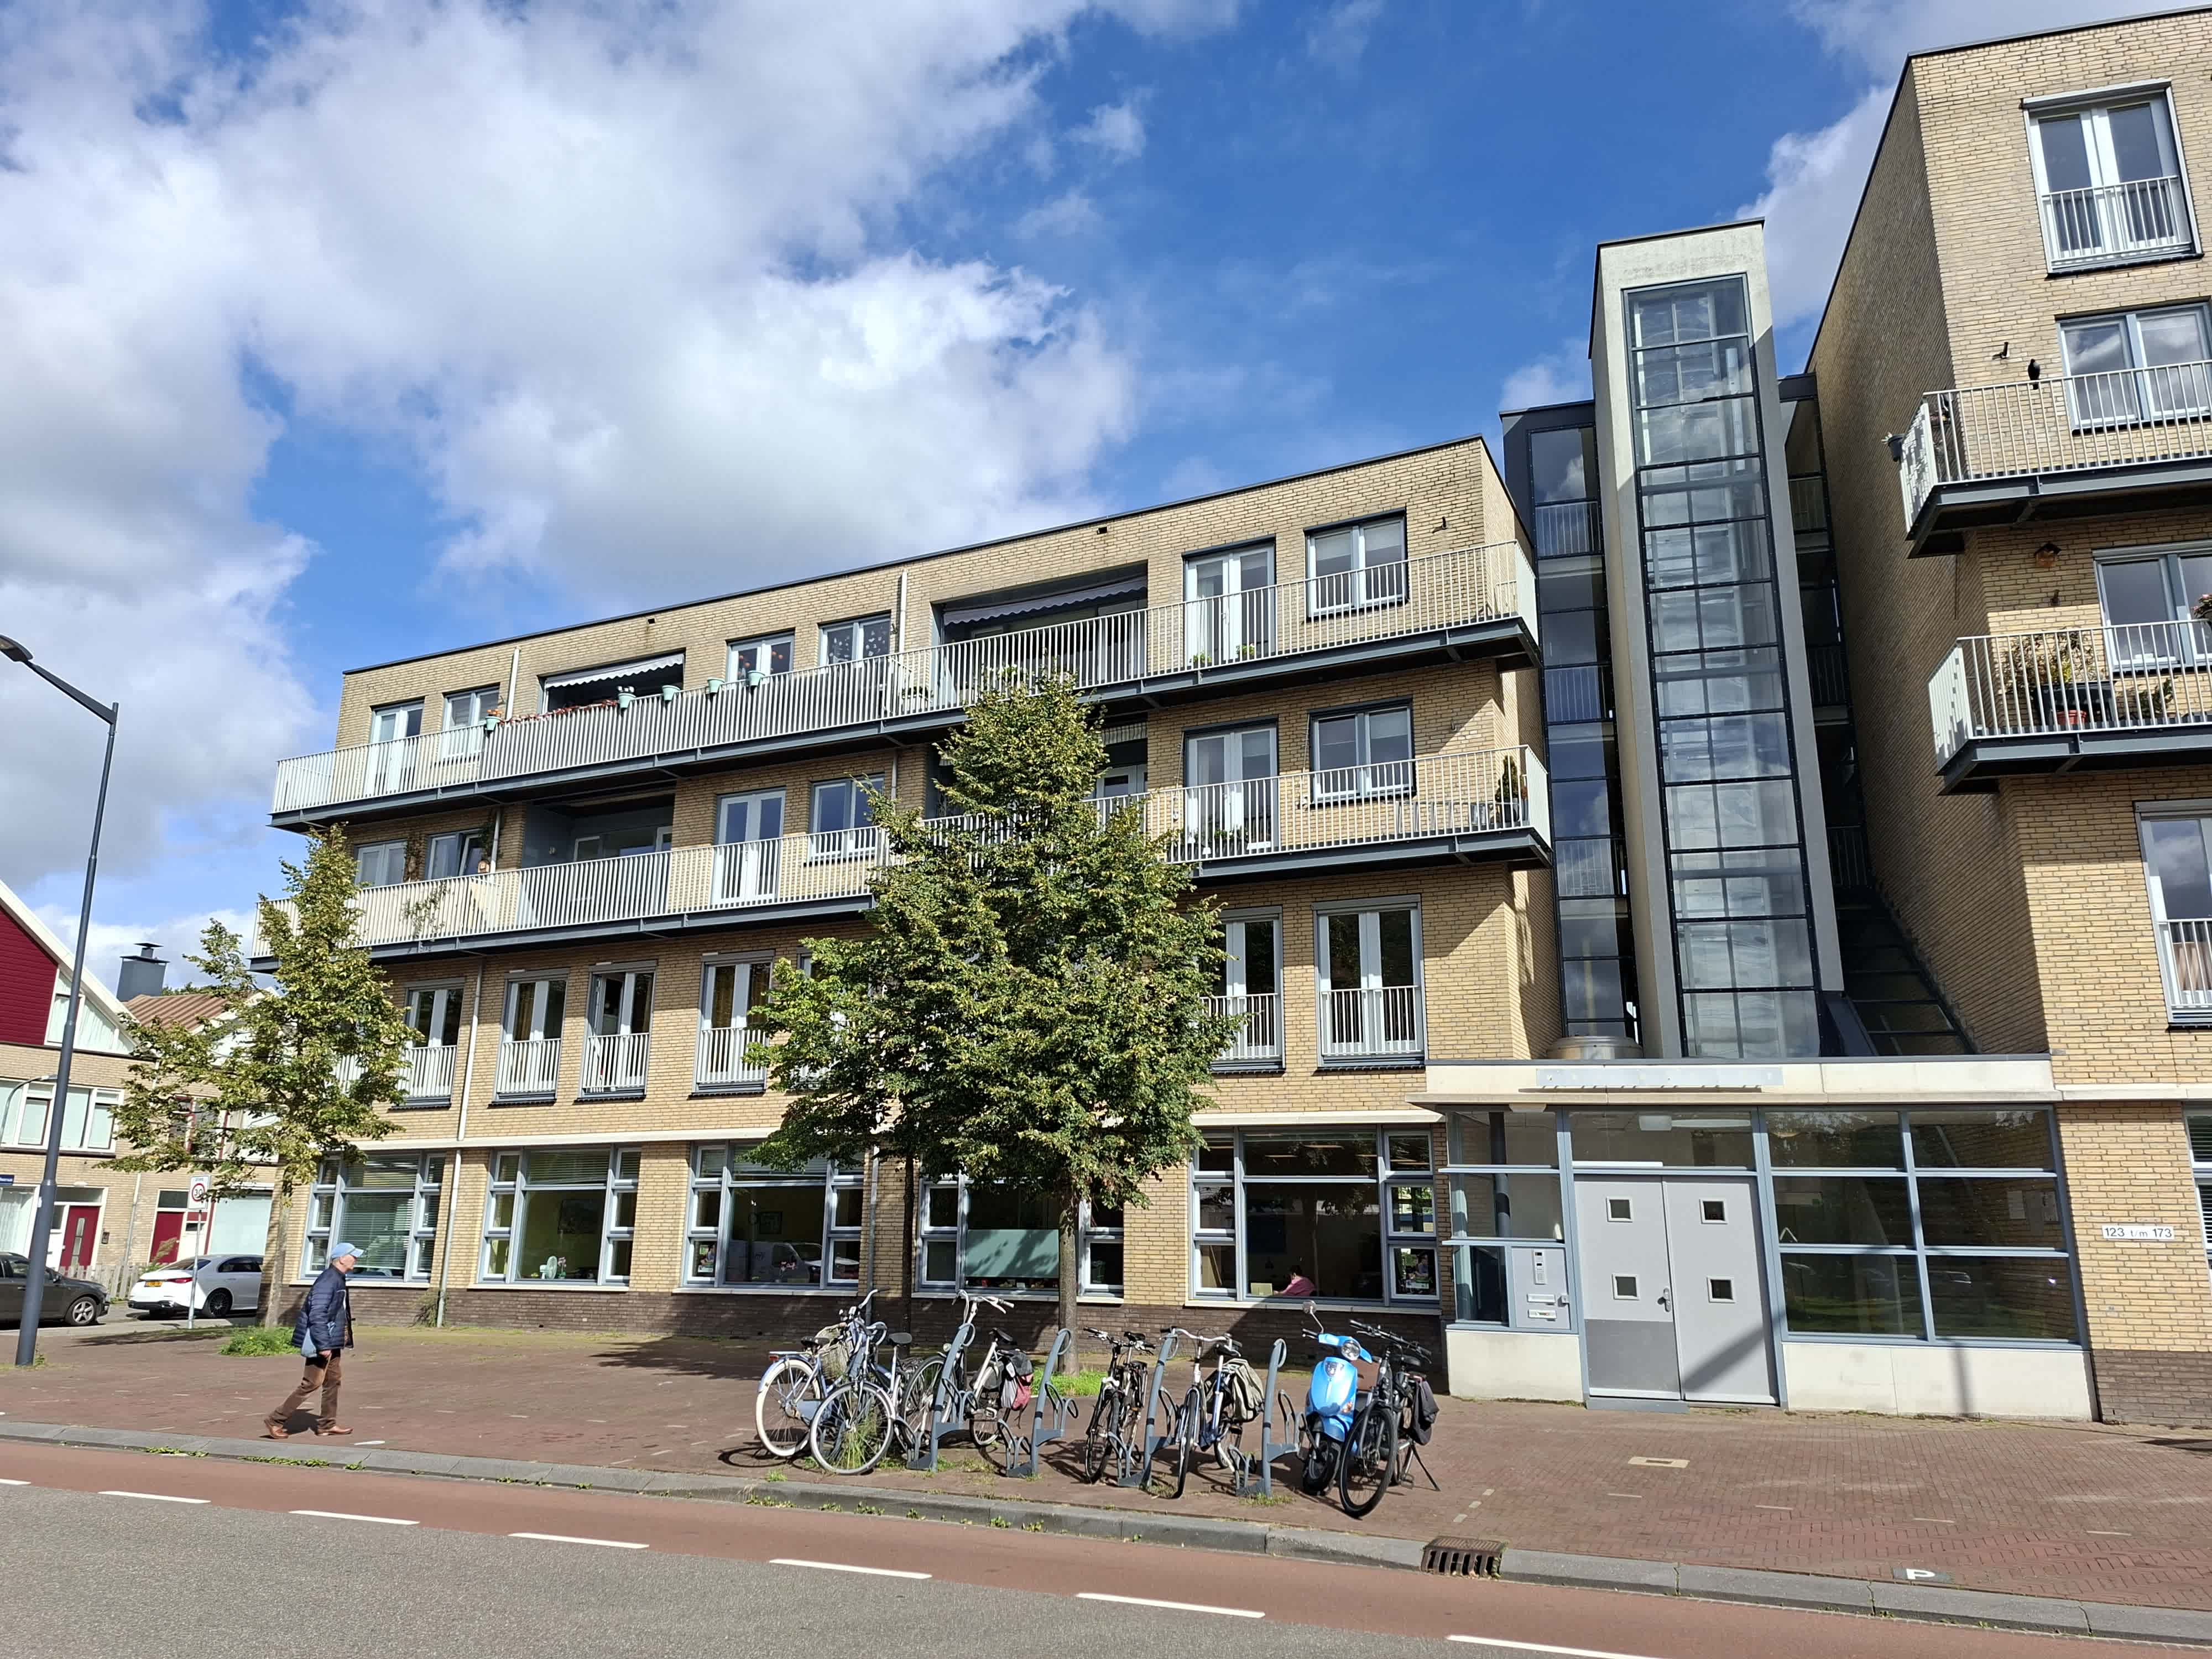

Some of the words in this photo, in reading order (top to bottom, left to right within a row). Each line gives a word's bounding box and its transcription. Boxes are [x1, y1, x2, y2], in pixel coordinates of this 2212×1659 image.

[2104, 1227, 2125, 1237] 123
[2130, 1229, 2148, 1238] t/m
[2152, 1228, 2172, 1238] 173
[1906, 1568, 1936, 1580] P
